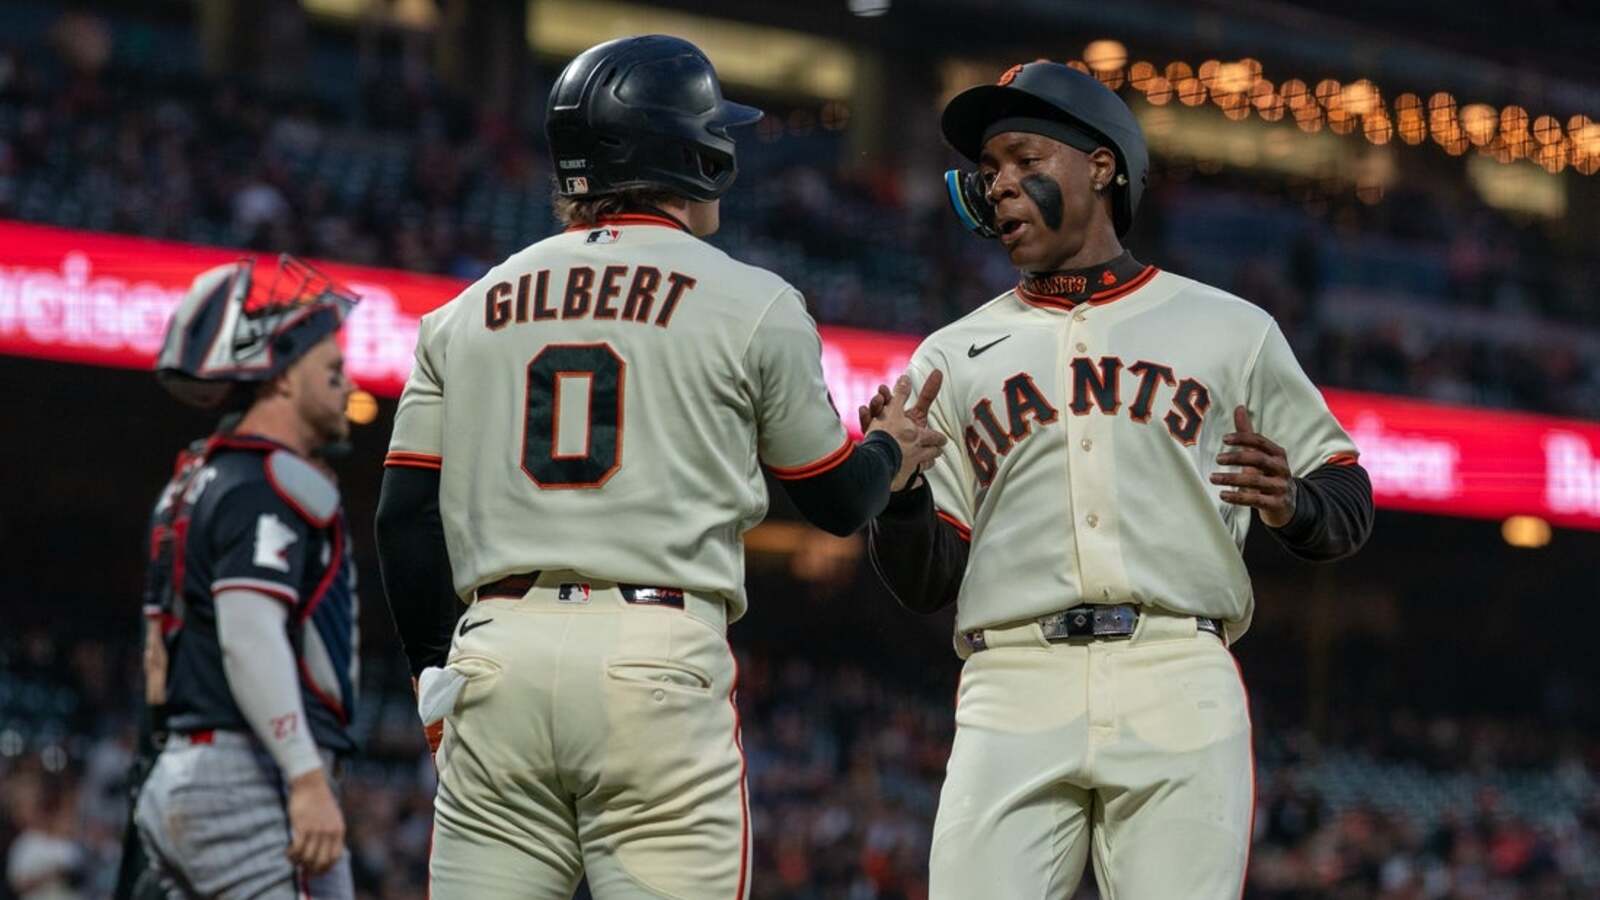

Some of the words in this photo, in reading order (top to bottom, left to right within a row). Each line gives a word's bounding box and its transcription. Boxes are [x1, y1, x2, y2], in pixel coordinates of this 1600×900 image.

[484, 264, 698, 332] GILBERT
[520, 342, 627, 490] 0
[964, 356, 1212, 488] GIANTS
[269, 709, 298, 743] 27
